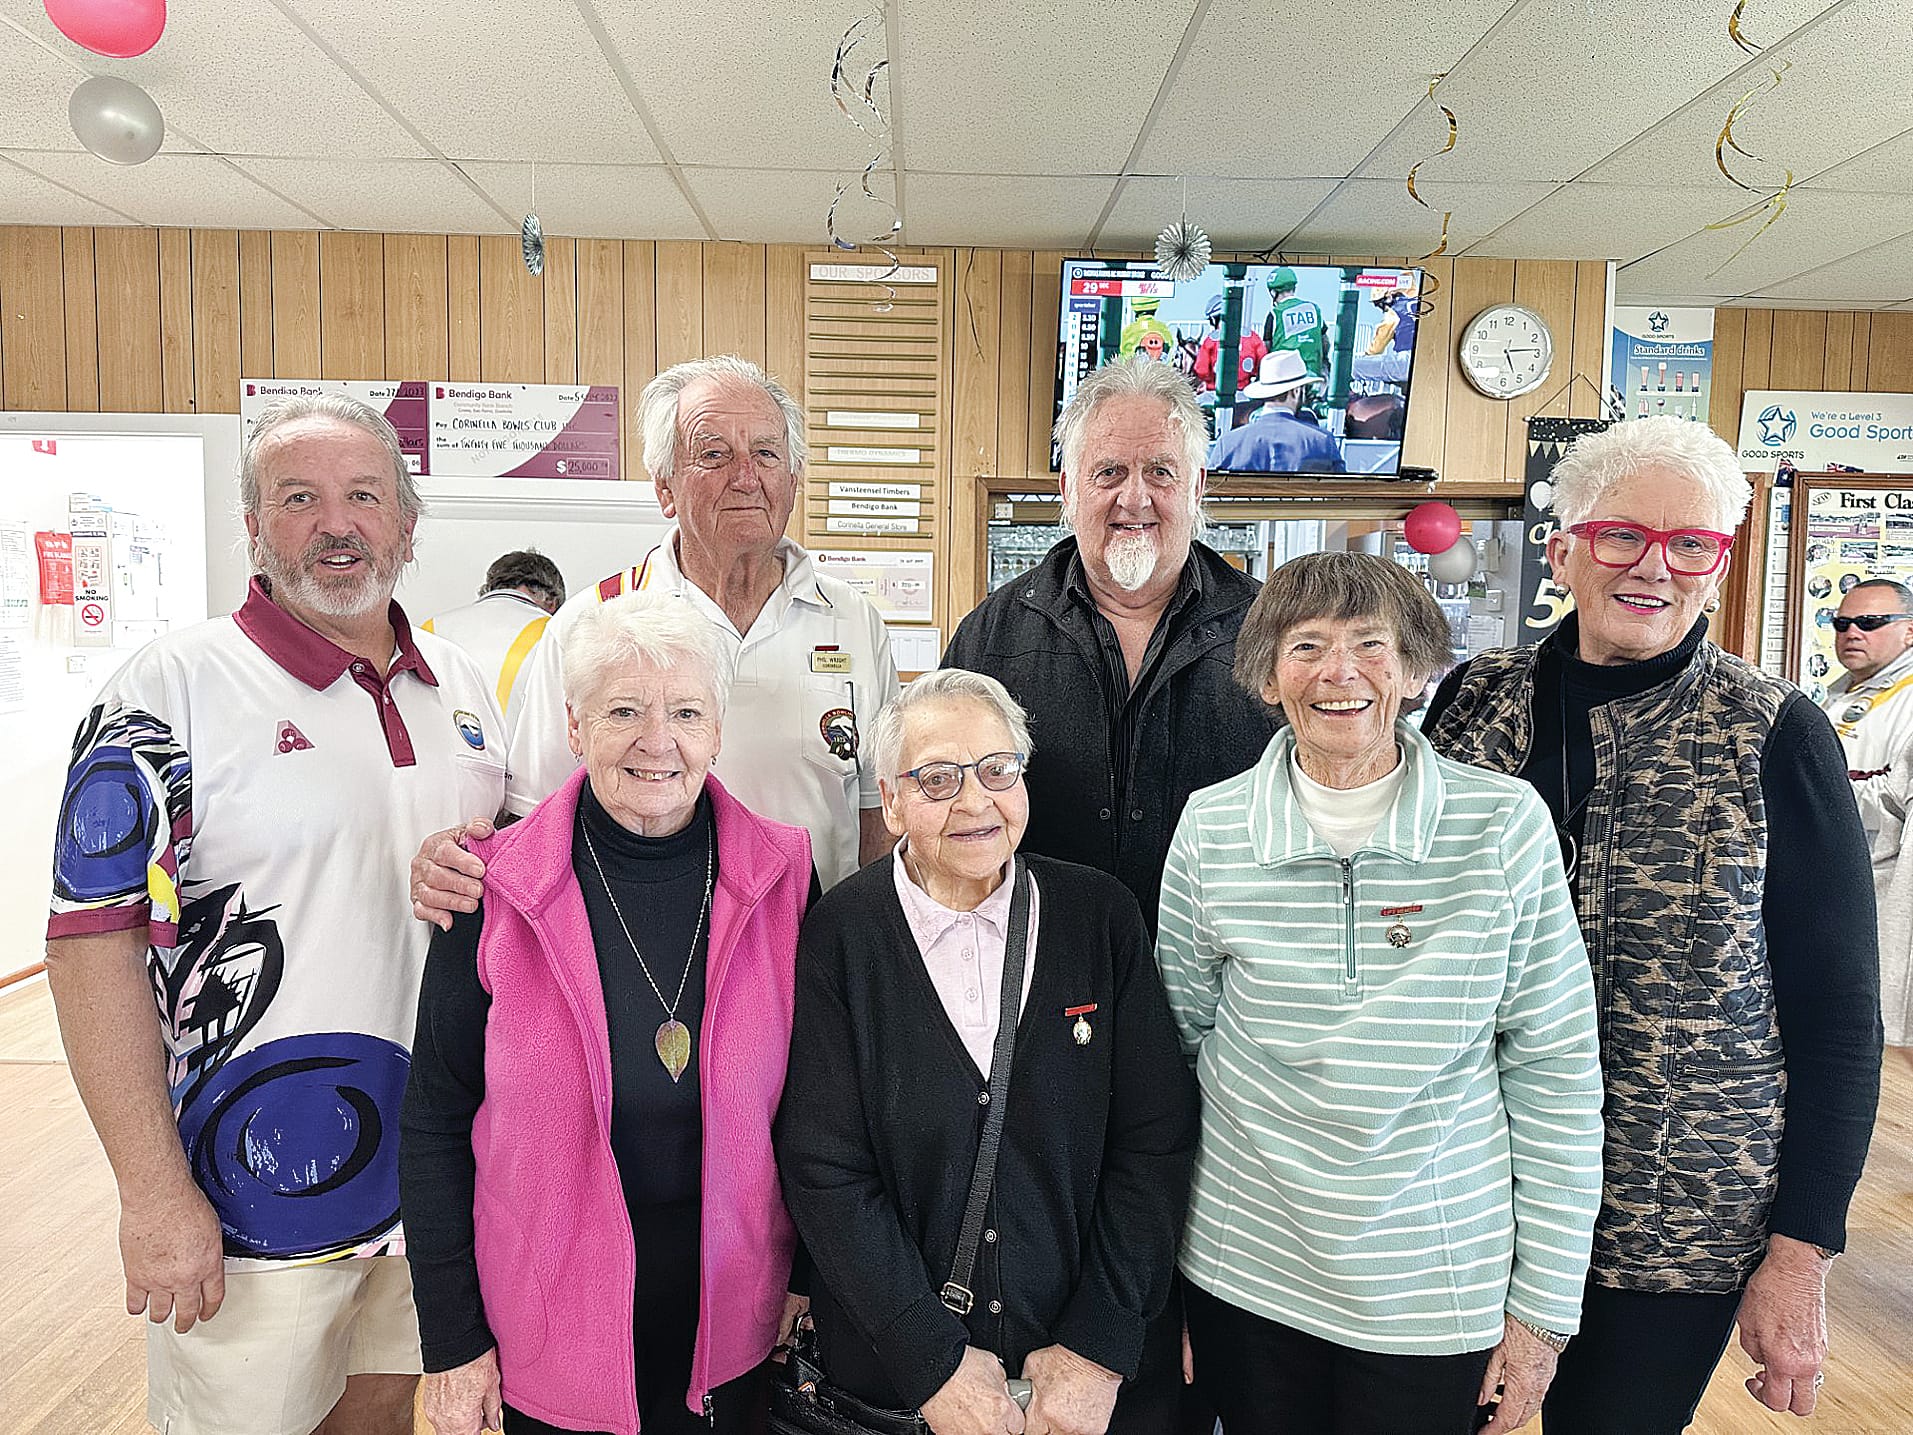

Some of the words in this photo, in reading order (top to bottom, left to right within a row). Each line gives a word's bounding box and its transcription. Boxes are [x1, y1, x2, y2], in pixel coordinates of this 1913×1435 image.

[819, 266, 848, 278] OUR
[1083, 282, 1098, 293] 29
[1286, 312, 1314, 325] TAB
[1504, 316, 1515, 326] 12
[1489, 320, 1497, 329] 11
[1523, 321, 1527, 330] 1
[1478, 330, 1487, 340] 10
[1531, 333, 1538, 343] 2
[1472, 344, 1479, 354] 9
[1533, 348, 1540, 358] 3
[1635, 345, 1675, 355] Standard
[1677, 345, 1704, 355] drinks
[1528, 363, 1535, 372] 4
[1500, 377, 1507, 387] 6
[1516, 374, 1523, 383] 5
[448, 389, 487, 401] Bendigo
[488, 390, 512, 400] Bank
[1811, 411, 1837, 420] We're
[1849, 412, 1874, 421] Level
[1876, 412, 1882, 421] 3
[453, 418, 497, 430] CORINELLA
[502, 420, 530, 431] BOWLS
[534, 420, 557, 431] CLUB
[1810, 424, 1861, 439] Good
[460, 438, 488, 449] TWENTY
[492, 440, 506, 450] FIVE
[1742, 450, 1768, 459] GOOD
[1770, 450, 1805, 459] SPORTS
[840, 486, 882, 494] Vansteensel
[883, 487, 910, 496] Timbers
[1840, 491, 1877, 509] First
[851, 503, 880, 511] Bendigo
[865, 521, 890, 530] General
[891, 522, 908, 531] Store
